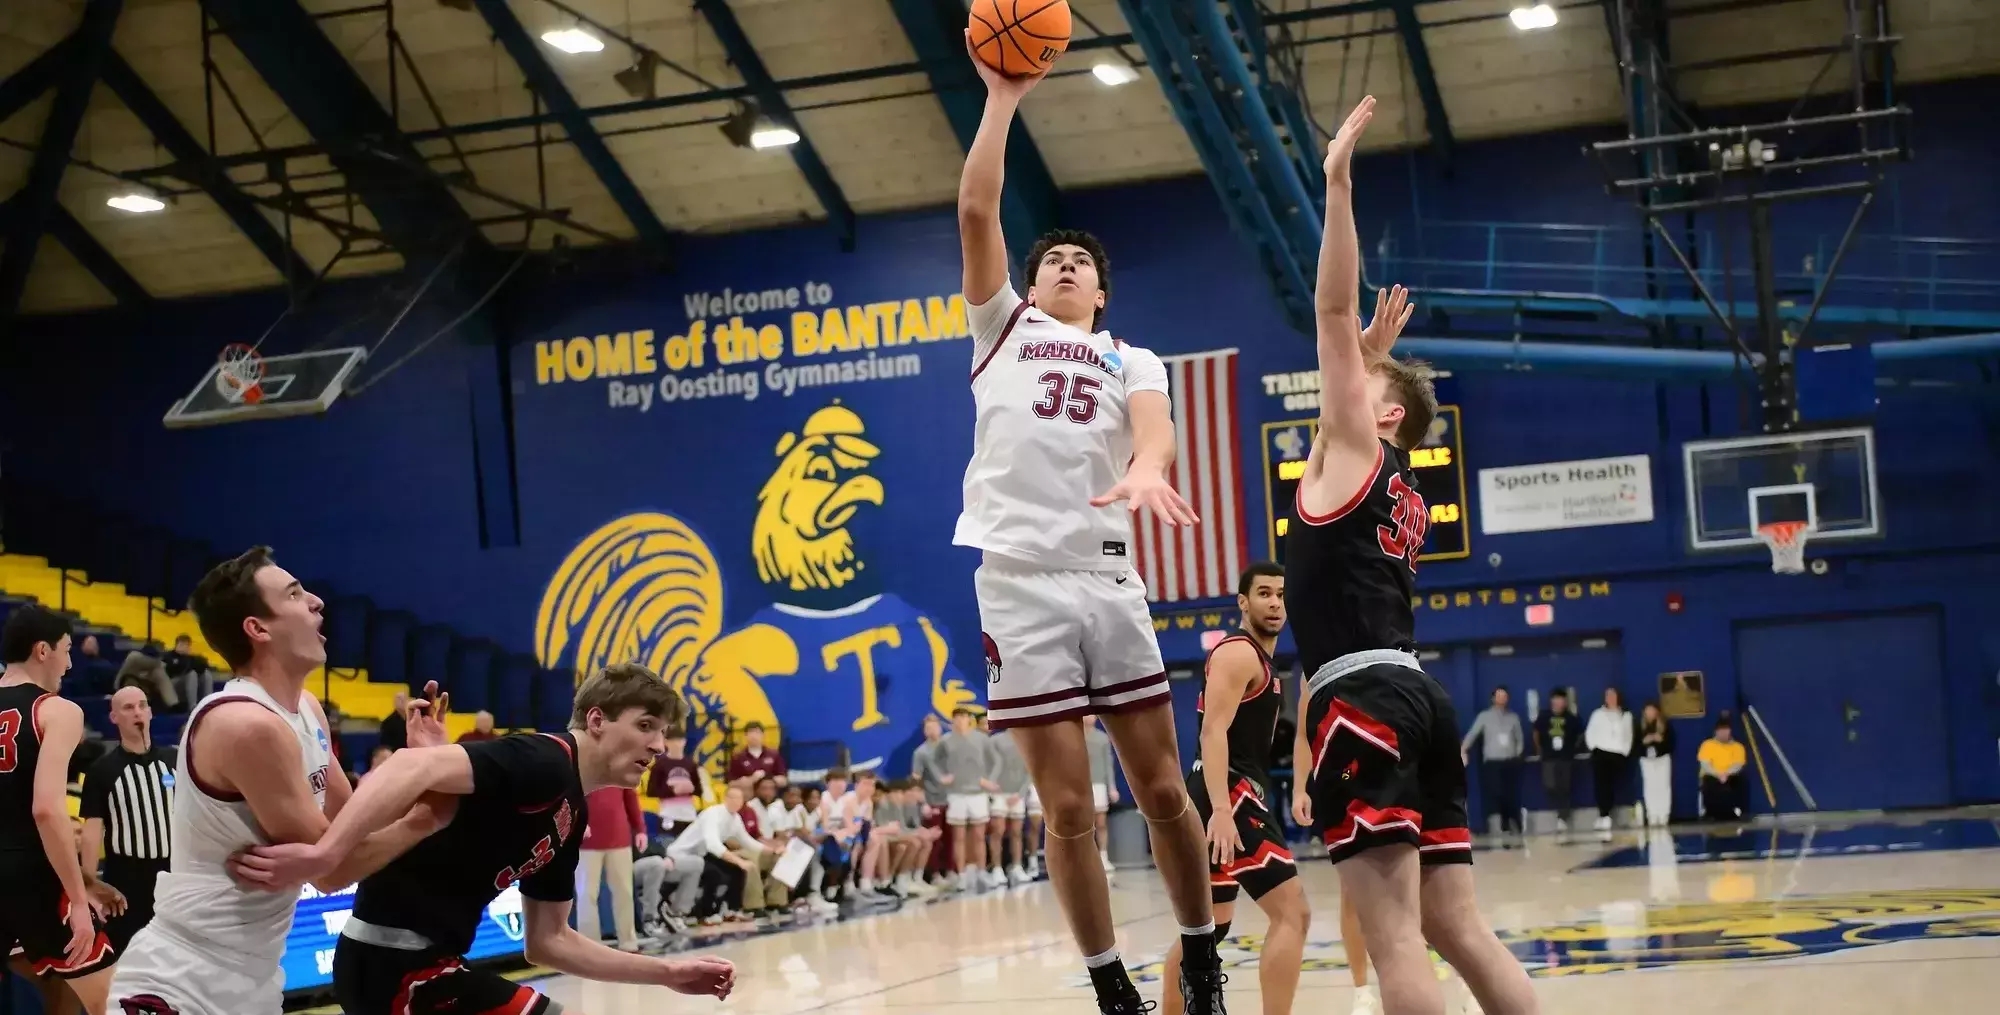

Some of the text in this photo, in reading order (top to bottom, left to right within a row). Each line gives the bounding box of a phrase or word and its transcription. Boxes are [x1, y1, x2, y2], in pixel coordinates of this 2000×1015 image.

[684, 280, 832, 319] Welcome to
[536, 329, 657, 384] HOME
[663, 320, 706, 371] of
[712, 316, 784, 365] the
[608, 351, 921, 412] Ray Oosting Gymnasium
[1032, 370, 1103, 424] 35
[1494, 463, 1636, 491] Sports Health
[1377, 472, 1426, 575] 30
[821, 623, 902, 732] T
